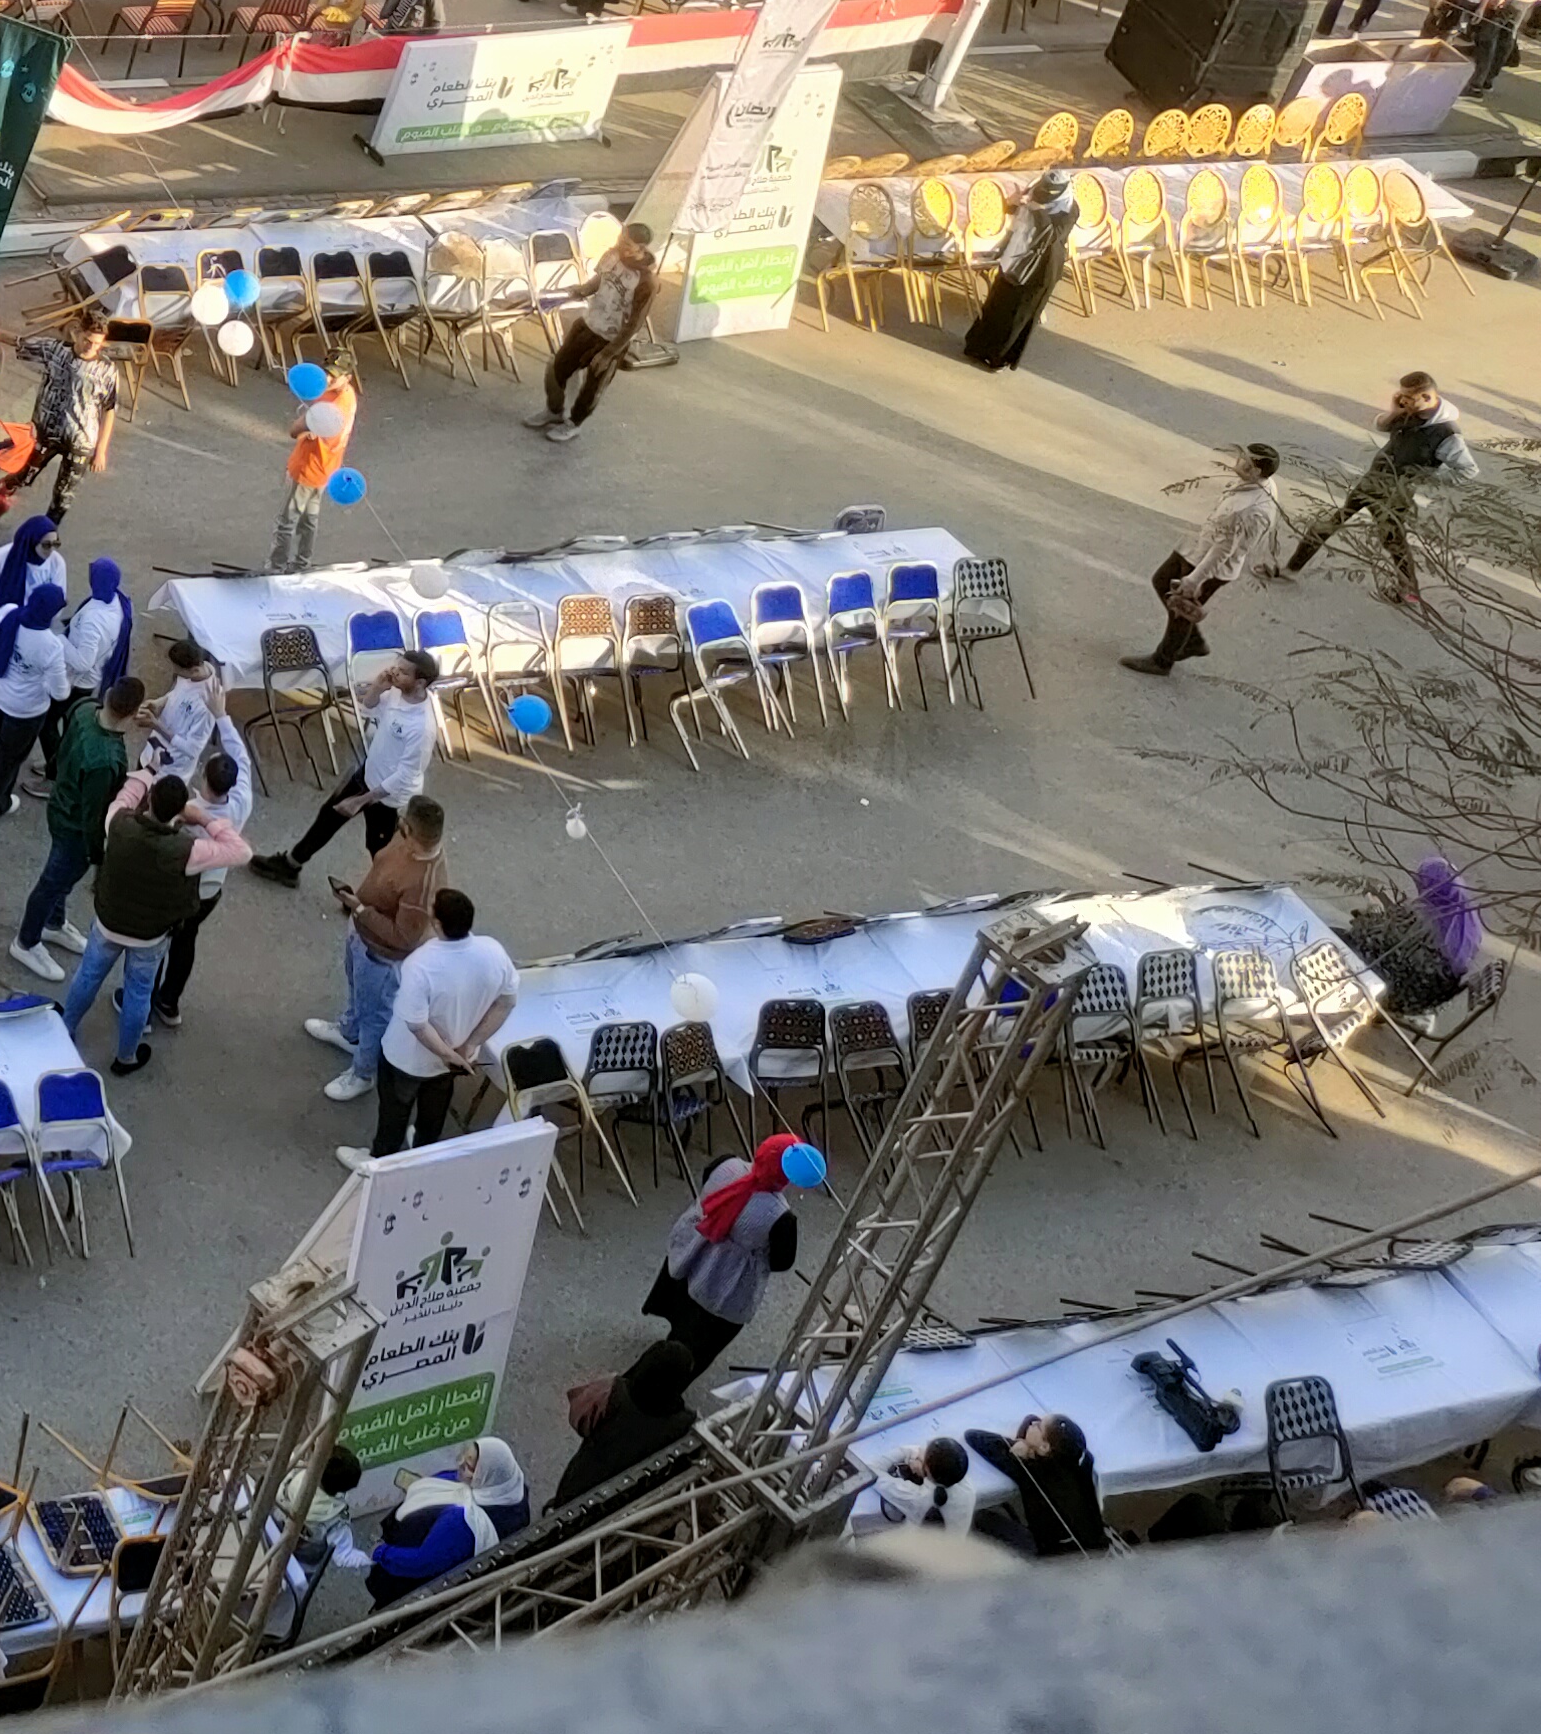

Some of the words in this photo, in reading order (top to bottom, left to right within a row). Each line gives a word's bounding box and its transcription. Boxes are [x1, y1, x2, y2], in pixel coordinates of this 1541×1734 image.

[431, 81, 473, 96] الطعام
[427, 91, 492, 110] المصري
[758, 208, 777, 217] بنك
[737, 276, 761, 289] قلب
[419, 1291, 444, 1309] صلاح
[446, 1282, 481, 1301] جمعية
[390, 1297, 418, 1317] الدين
[427, 1331, 460, 1347] بنك
[364, 1338, 424, 1371] الطعام
[361, 1346, 456, 1391] المصري
[436, 1383, 489, 1411] إفطار
[336, 1410, 395, 1444] الفيوم
[404, 1424, 440, 1447] قلب
[443, 1417, 469, 1436] من
